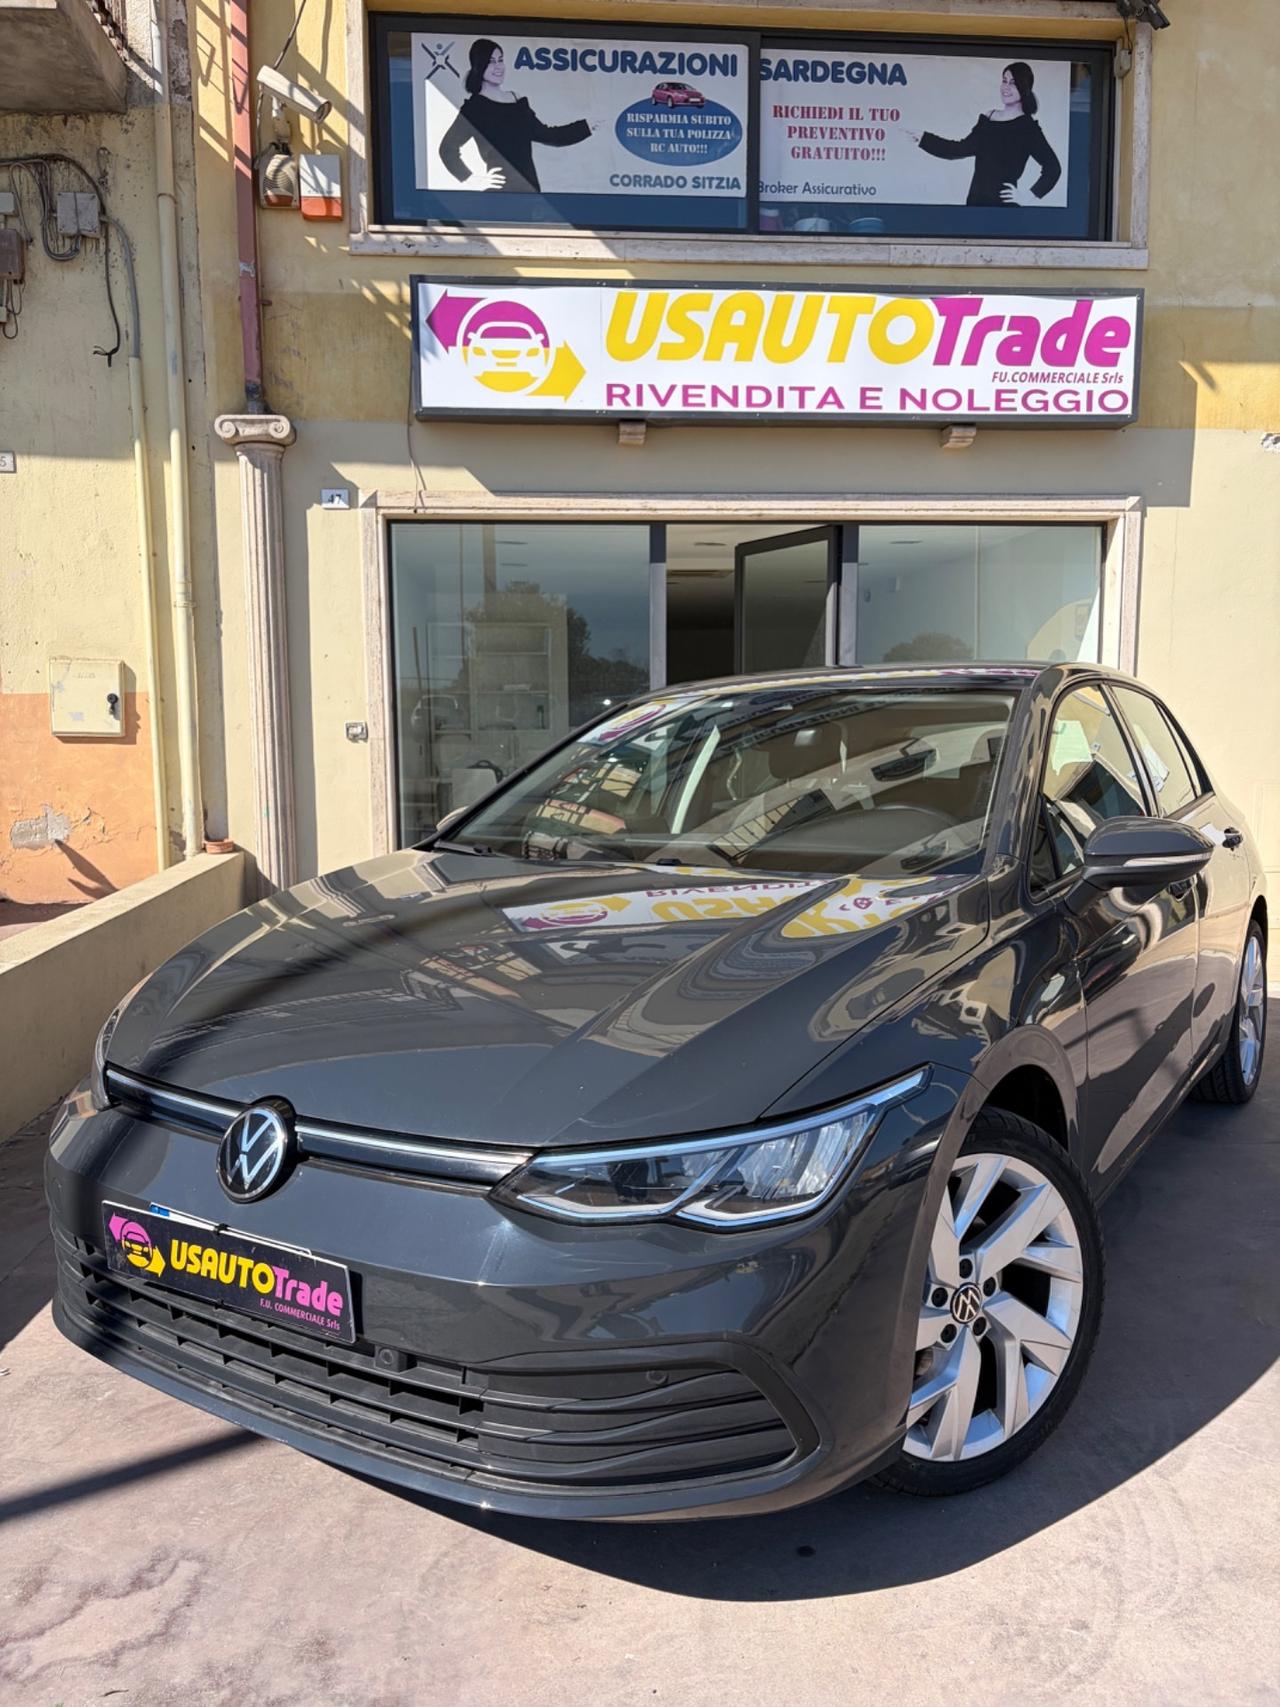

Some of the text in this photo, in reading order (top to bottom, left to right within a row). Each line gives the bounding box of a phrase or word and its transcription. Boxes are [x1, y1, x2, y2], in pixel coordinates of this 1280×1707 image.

[513, 46, 908, 86] ASSICURAZIONI SARDEGNA
[626, 113, 731, 125] RISPARMIA SUBITO
[772, 105, 901, 122] RICHIEDI IL TUO
[626, 128, 731, 140] SULLA TUA POLIZZA
[787, 126, 886, 142] PREVENTIVO
[650, 143, 708, 154] RC AUTO!!!
[790, 146, 886, 161] GRATUITO!!!
[609, 174, 741, 190] CORRADO SITZIA
[757, 181, 877, 196] Broker Assicurativo
[1101, 372, 1124, 384] Srls
[606, 383, 1129, 413] RIVENDITA E NOLEGGIO
[274, 1302, 325, 1327] COMMERCIALE
